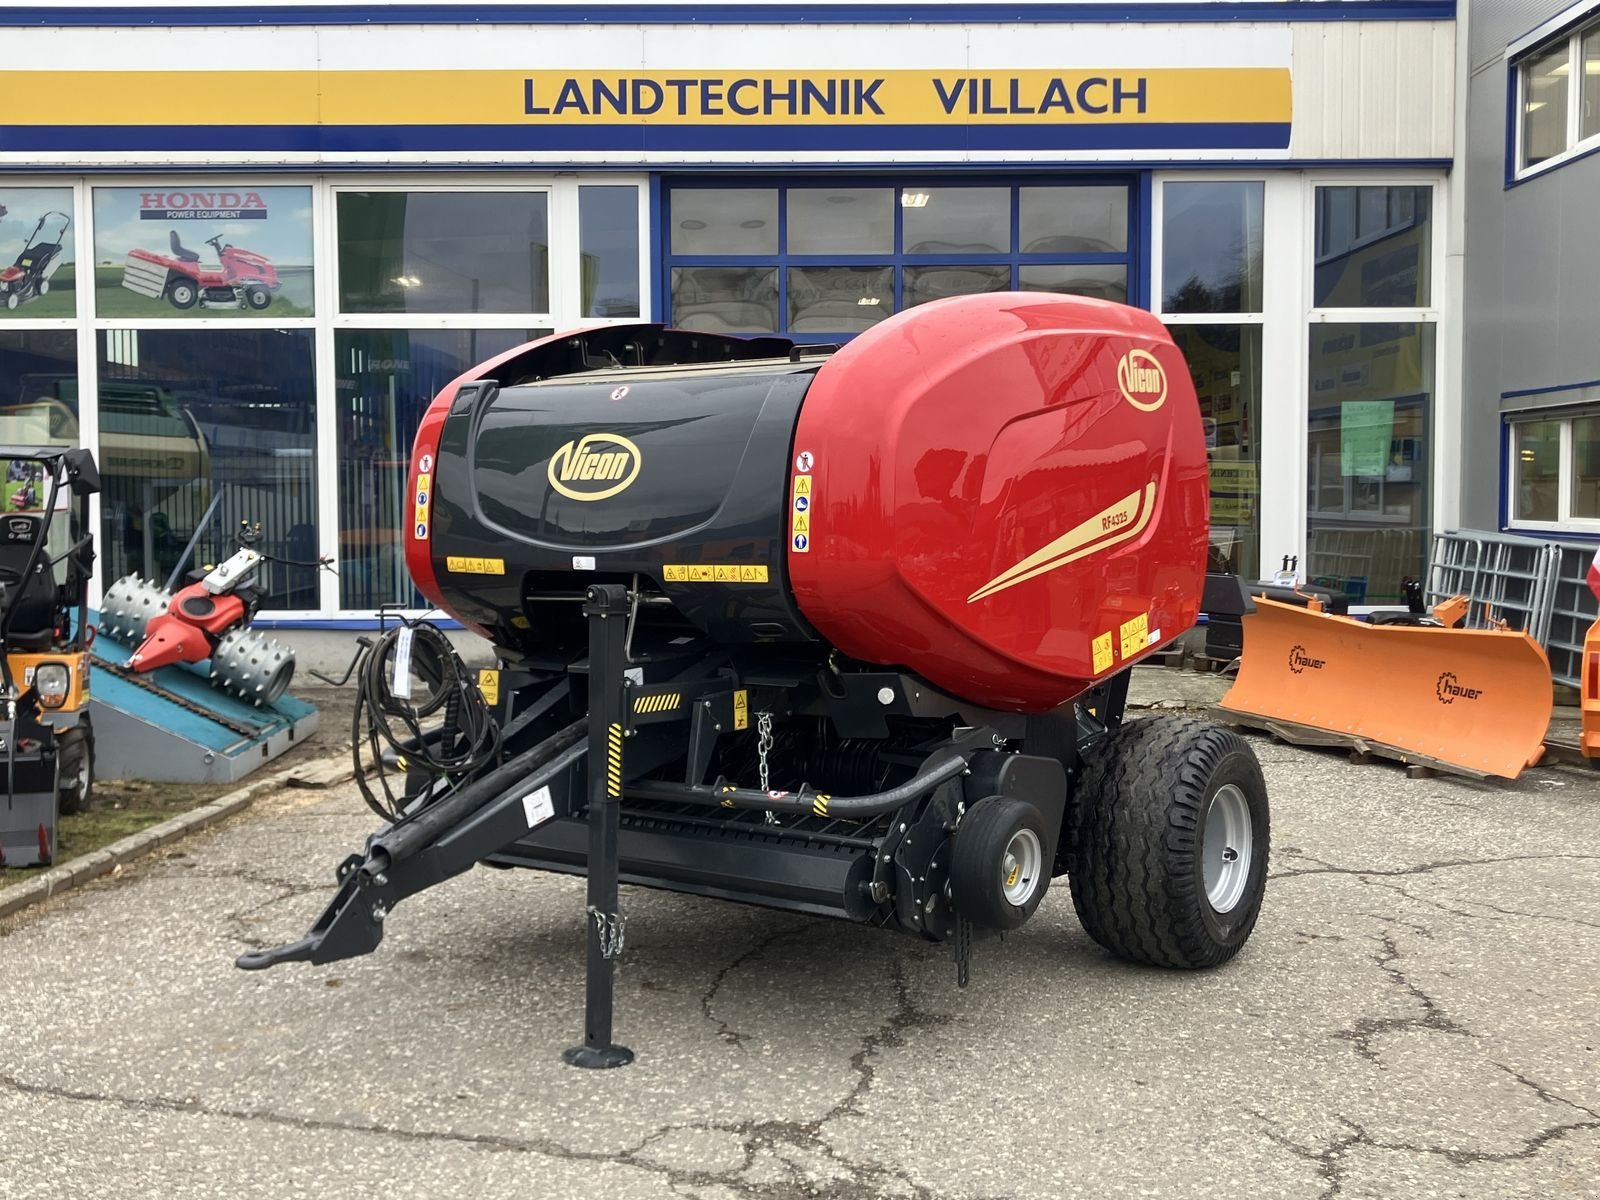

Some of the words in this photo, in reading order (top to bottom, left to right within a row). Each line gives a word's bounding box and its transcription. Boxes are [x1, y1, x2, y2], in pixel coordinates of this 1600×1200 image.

[524, 78, 885, 116] LANDTECHNIK
[932, 77, 1147, 115] VILLACH
[140, 192, 268, 209] HONDA
[166, 210, 196, 219] POWER
[196, 210, 241, 219] EQUIPMENT
[1122, 352, 1162, 394] Vicon
[556, 437, 632, 483] Vicon
[1101, 510, 1128, 531] RF4325
[1294, 652, 1326, 670] hauer
[1442, 679, 1483, 700] hauer
